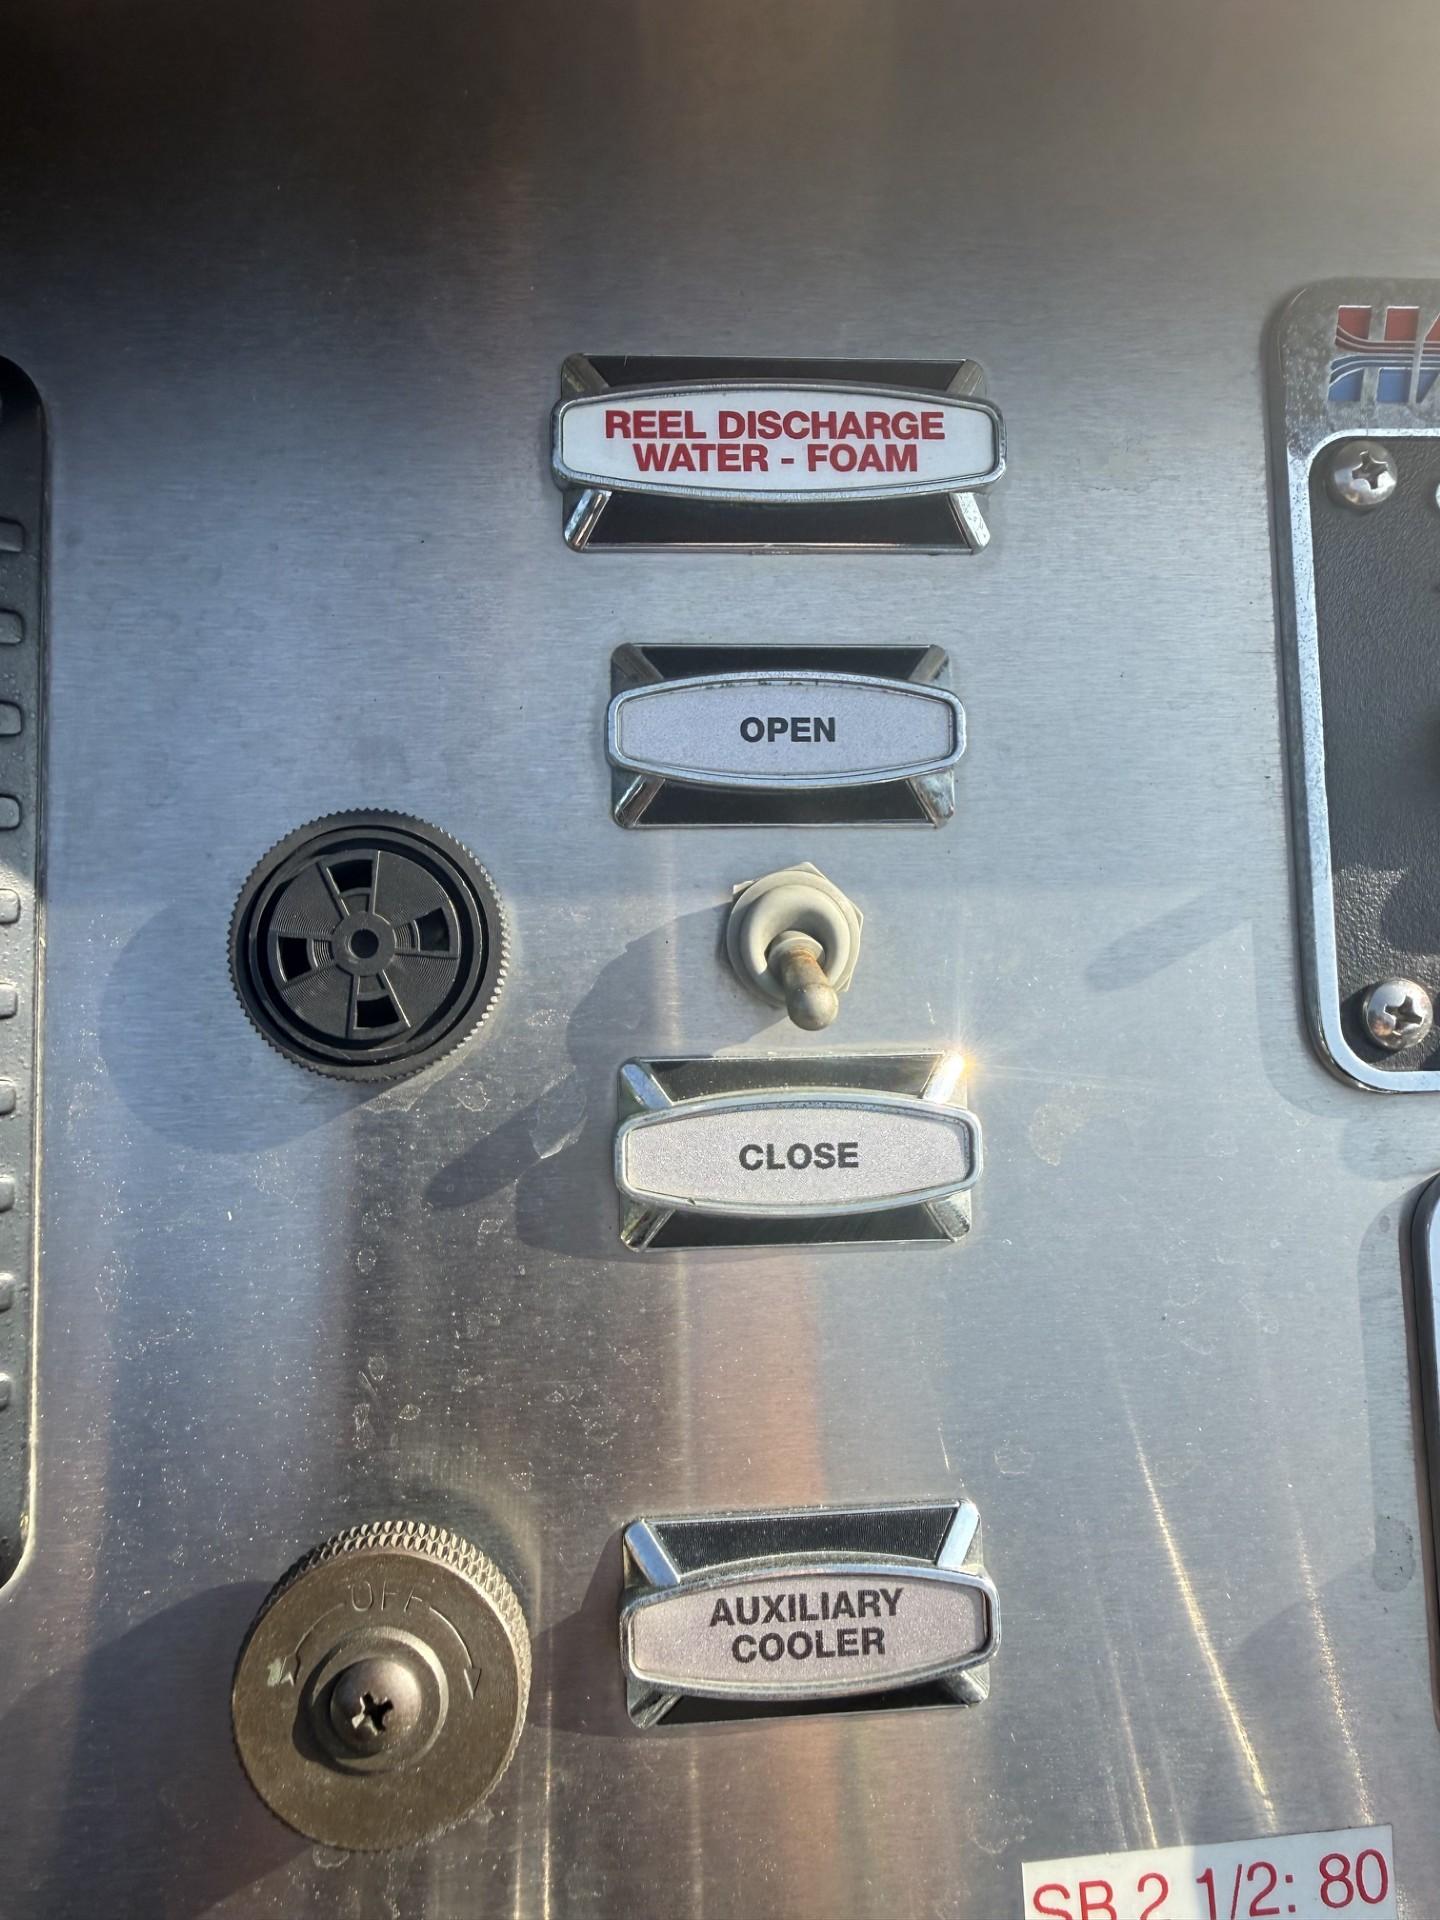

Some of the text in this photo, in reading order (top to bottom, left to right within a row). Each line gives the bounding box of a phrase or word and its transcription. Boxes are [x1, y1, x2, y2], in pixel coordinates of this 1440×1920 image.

[605, 410, 946, 440] REEL DISCHARGE
[632, 443, 918, 472] WATER - FOAM
[740, 717, 835, 742] OPEN
[739, 1142, 859, 1170] CLOSE
[350, 1579, 426, 1613] OFF
[710, 1587, 904, 1627] AUXILIARY
[731, 1626, 886, 1663] COOLER
[1137, 1872, 1169, 1920] 2
[1196, 1861, 1297, 1920] 1/2:
[1319, 1848, 1389, 1908] 80
